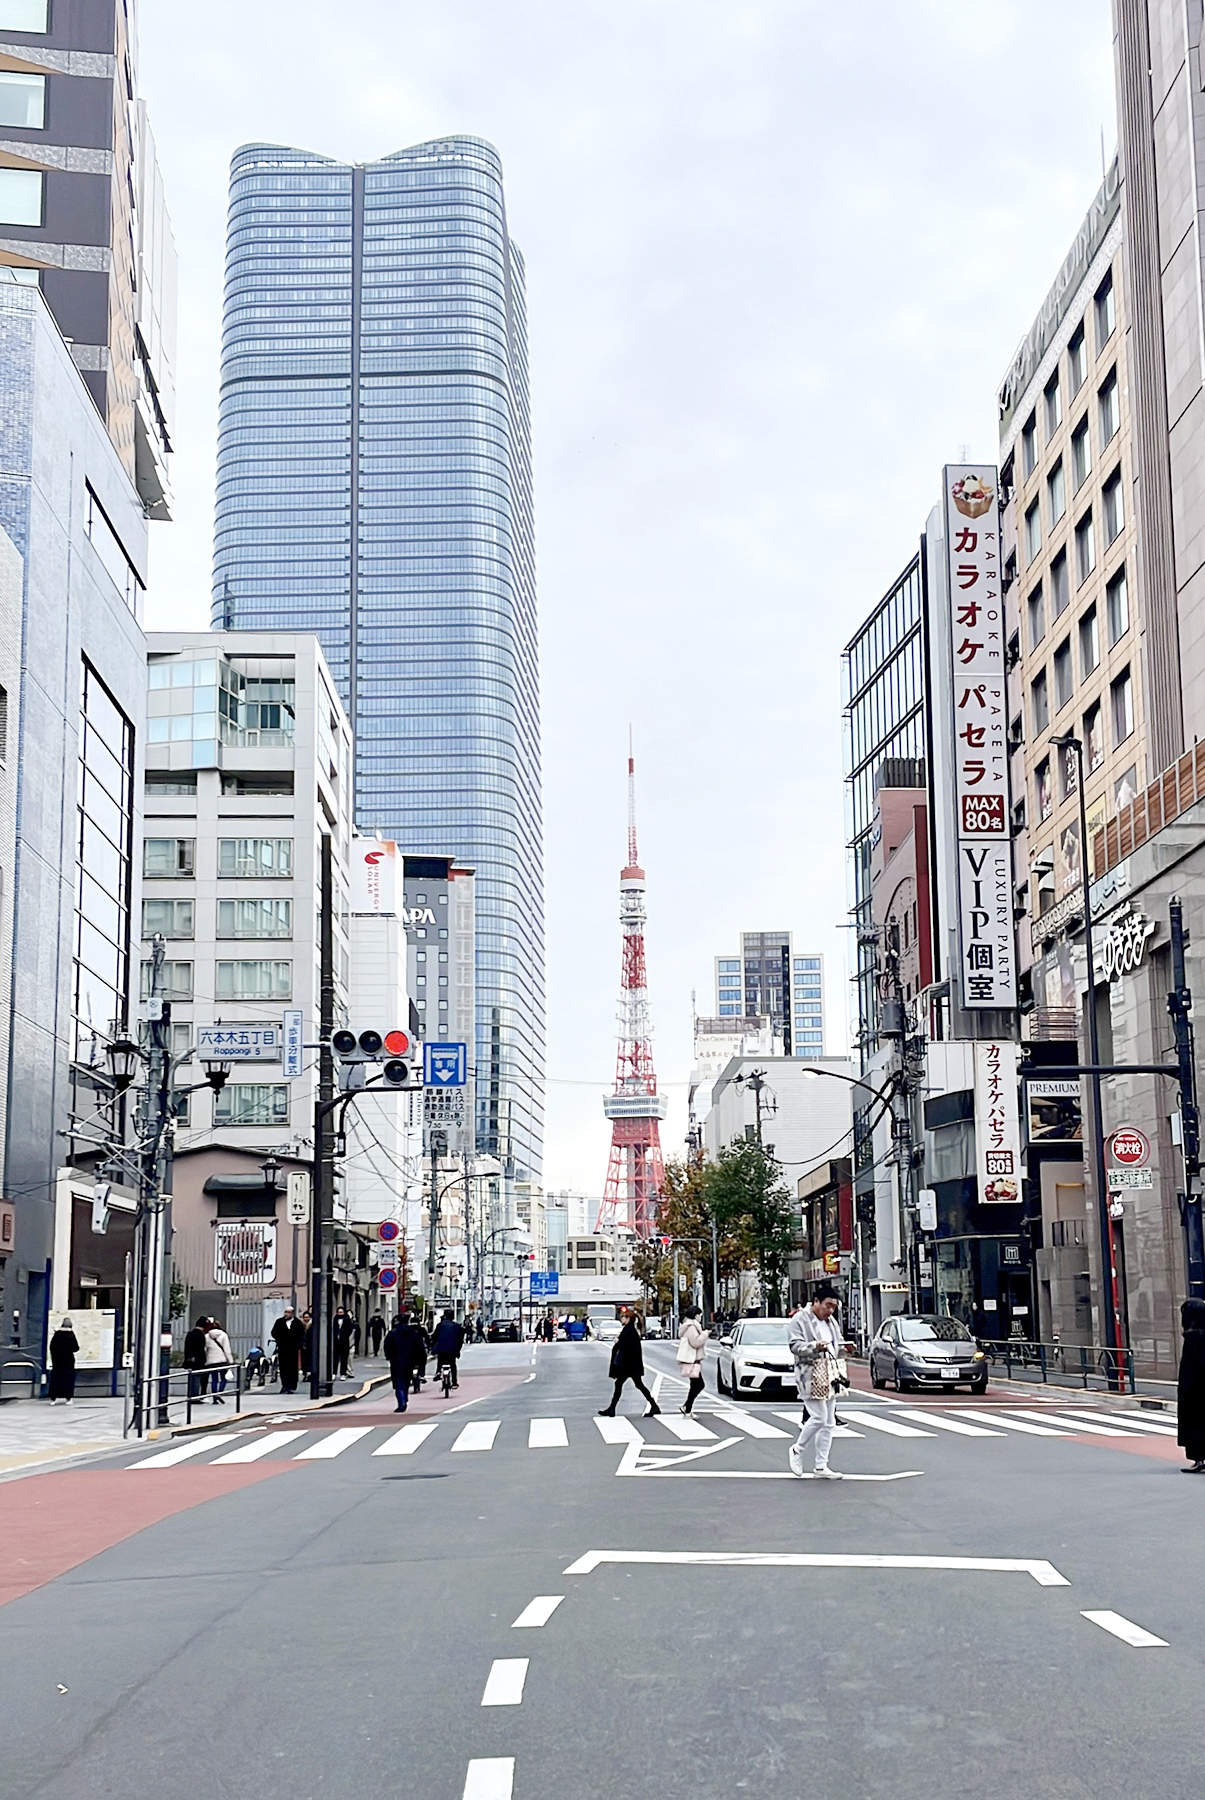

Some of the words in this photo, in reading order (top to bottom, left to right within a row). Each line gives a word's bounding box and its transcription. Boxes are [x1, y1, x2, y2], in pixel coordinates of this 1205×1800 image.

[954, 527, 984, 665] カラオケ
[984, 532, 1000, 658] KARAOKE
[958, 684, 987, 786] パセラ
[990, 690, 1003, 781] PASELA
[965, 797, 1000, 811] MAX
[965, 811, 1003, 830] 80名
[994, 859, 1008, 926] LUXURY
[962, 848, 995, 1001] VIP個室
[997, 935, 1010, 989] PARTY
[200, 1031, 275, 1045] 六本木五丁目
[214, 1047, 251, 1056] Roppongi
[255, 1048, 261, 1056] 5
[1030, 1083, 1080, 1093] PREMIUM
[1115, 1141, 1142, 1155] 消火栓
